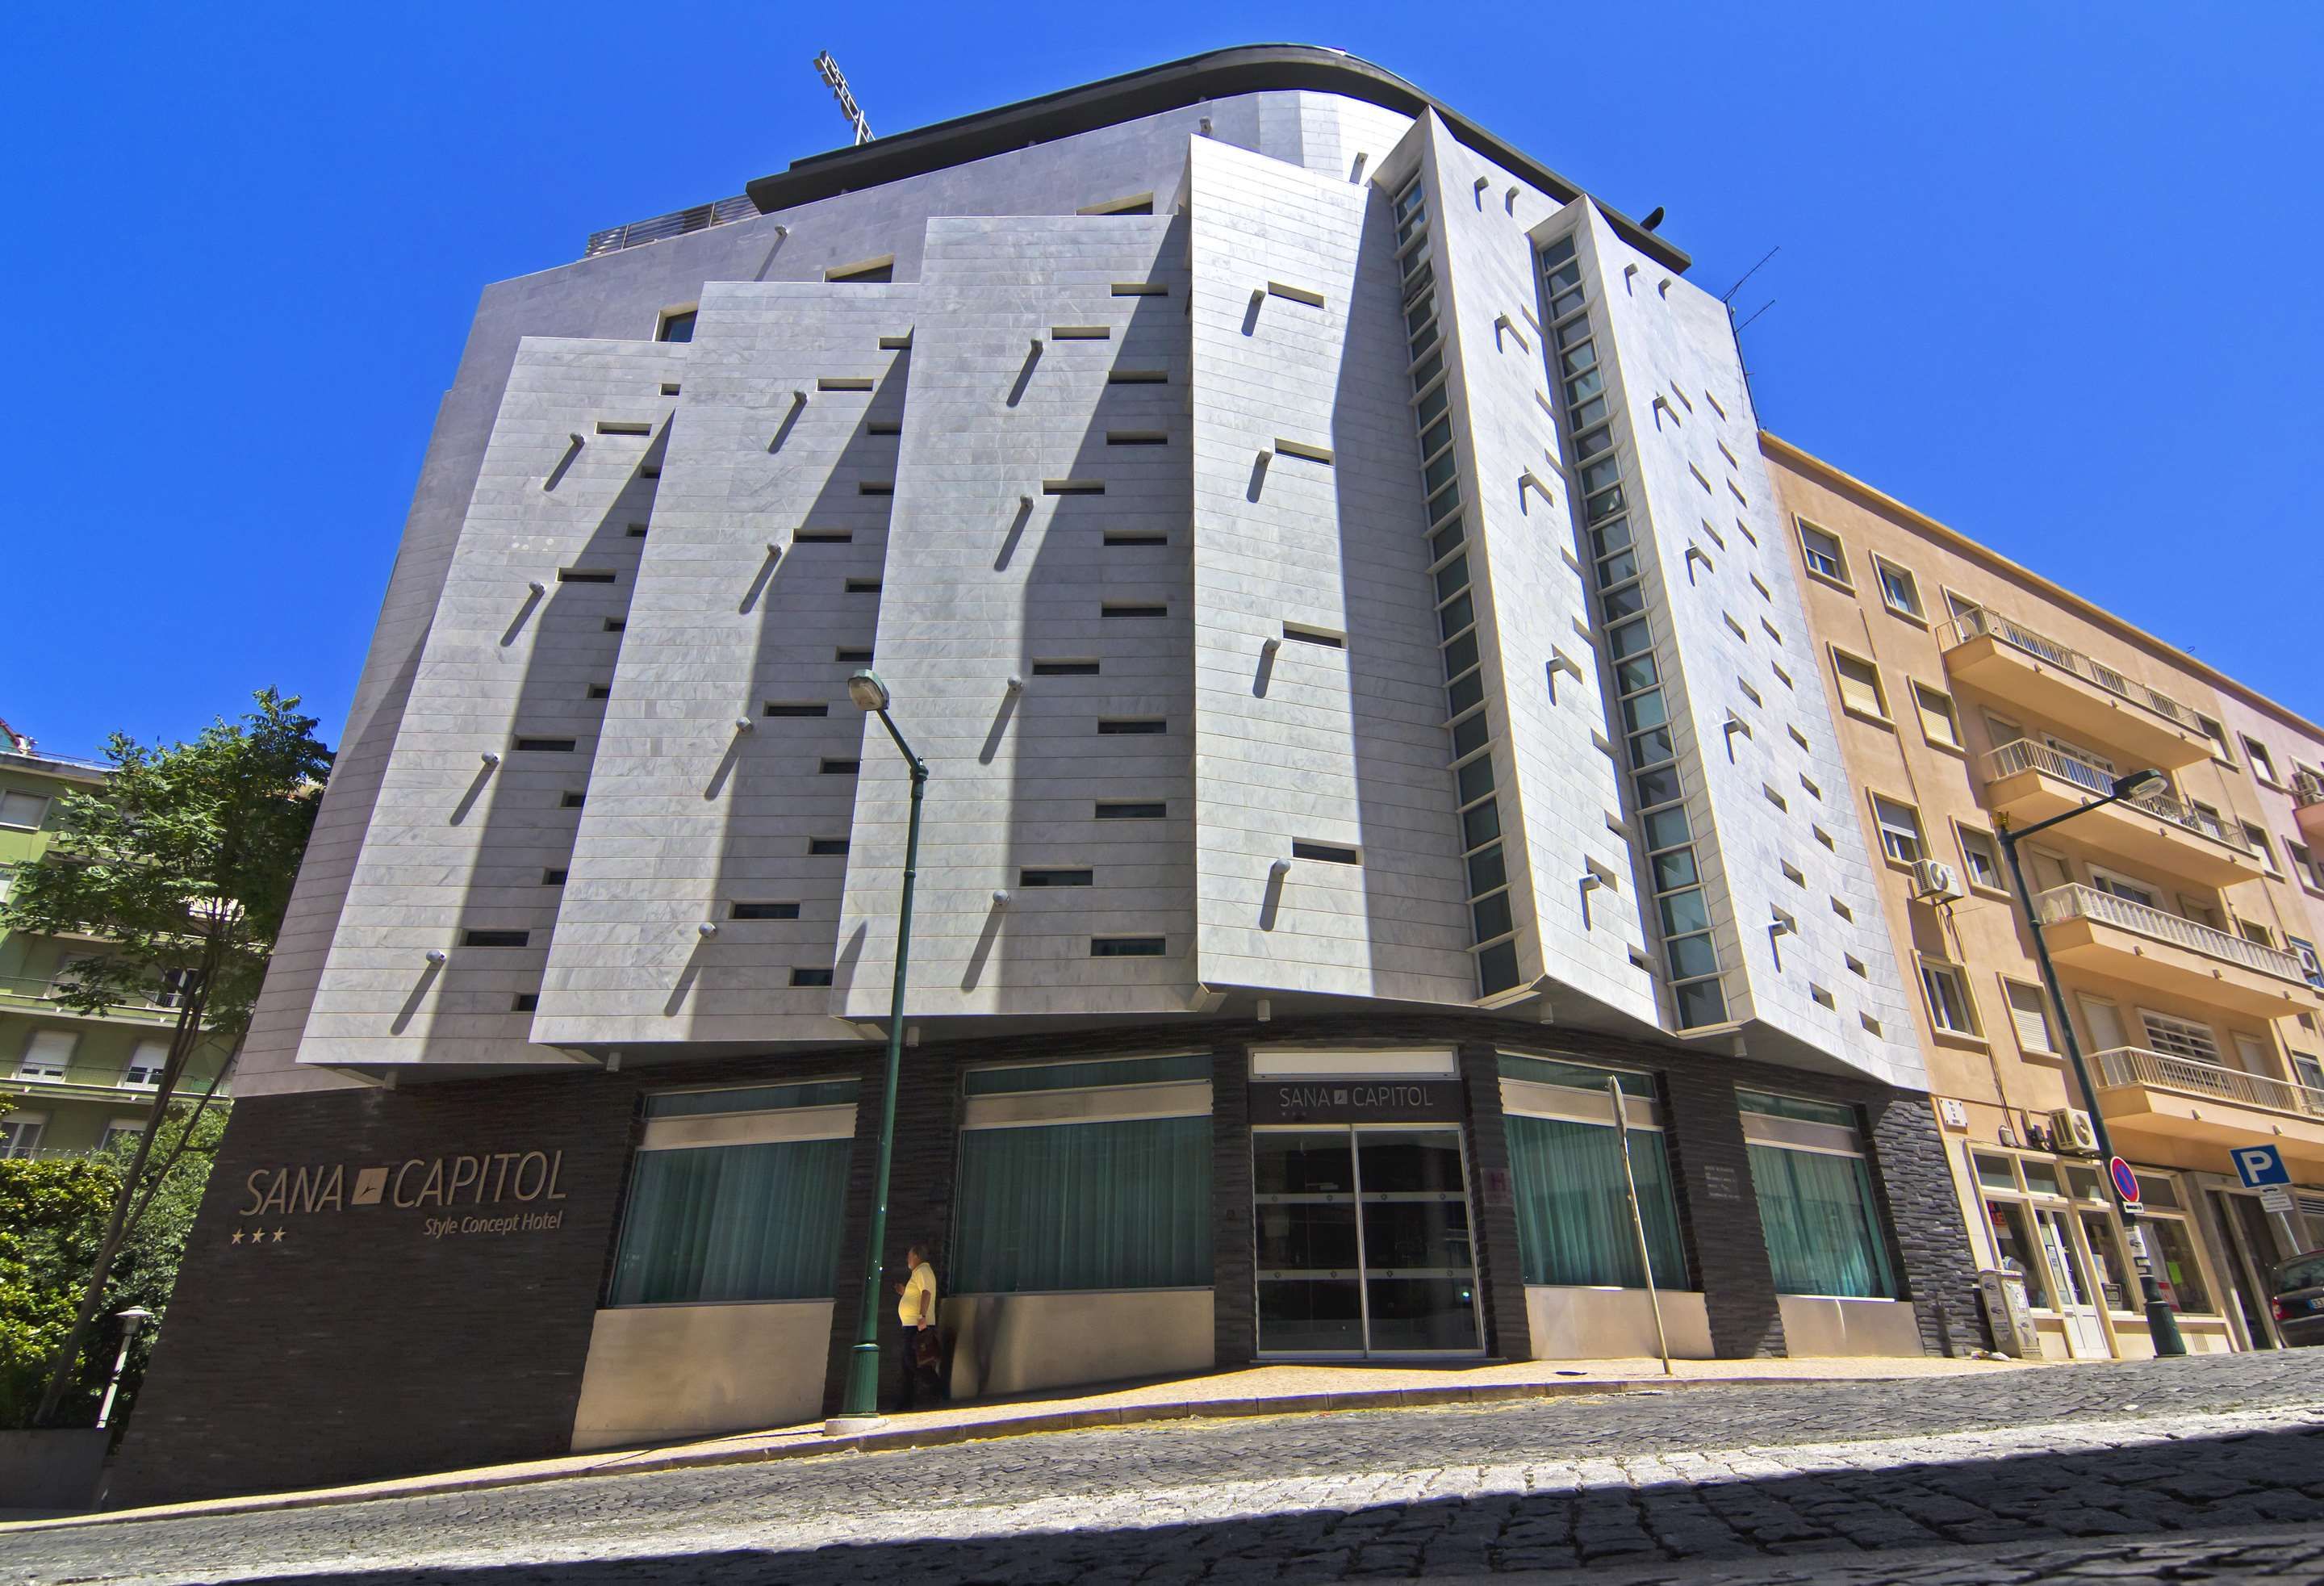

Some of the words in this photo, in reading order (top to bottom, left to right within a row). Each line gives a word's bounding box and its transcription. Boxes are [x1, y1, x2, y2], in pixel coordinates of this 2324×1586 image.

[1279, 1087, 1331, 1107] SANA
[1352, 1086, 1433, 1107] CAPITOL
[2240, 1150, 2273, 1183] P
[240, 1164, 344, 1216] SANA
[393, 1149, 566, 1207] CAPITOL
[424, 1216, 458, 1239] Style
[461, 1214, 520, 1236] Concept
[521, 1211, 563, 1231] Hotel
